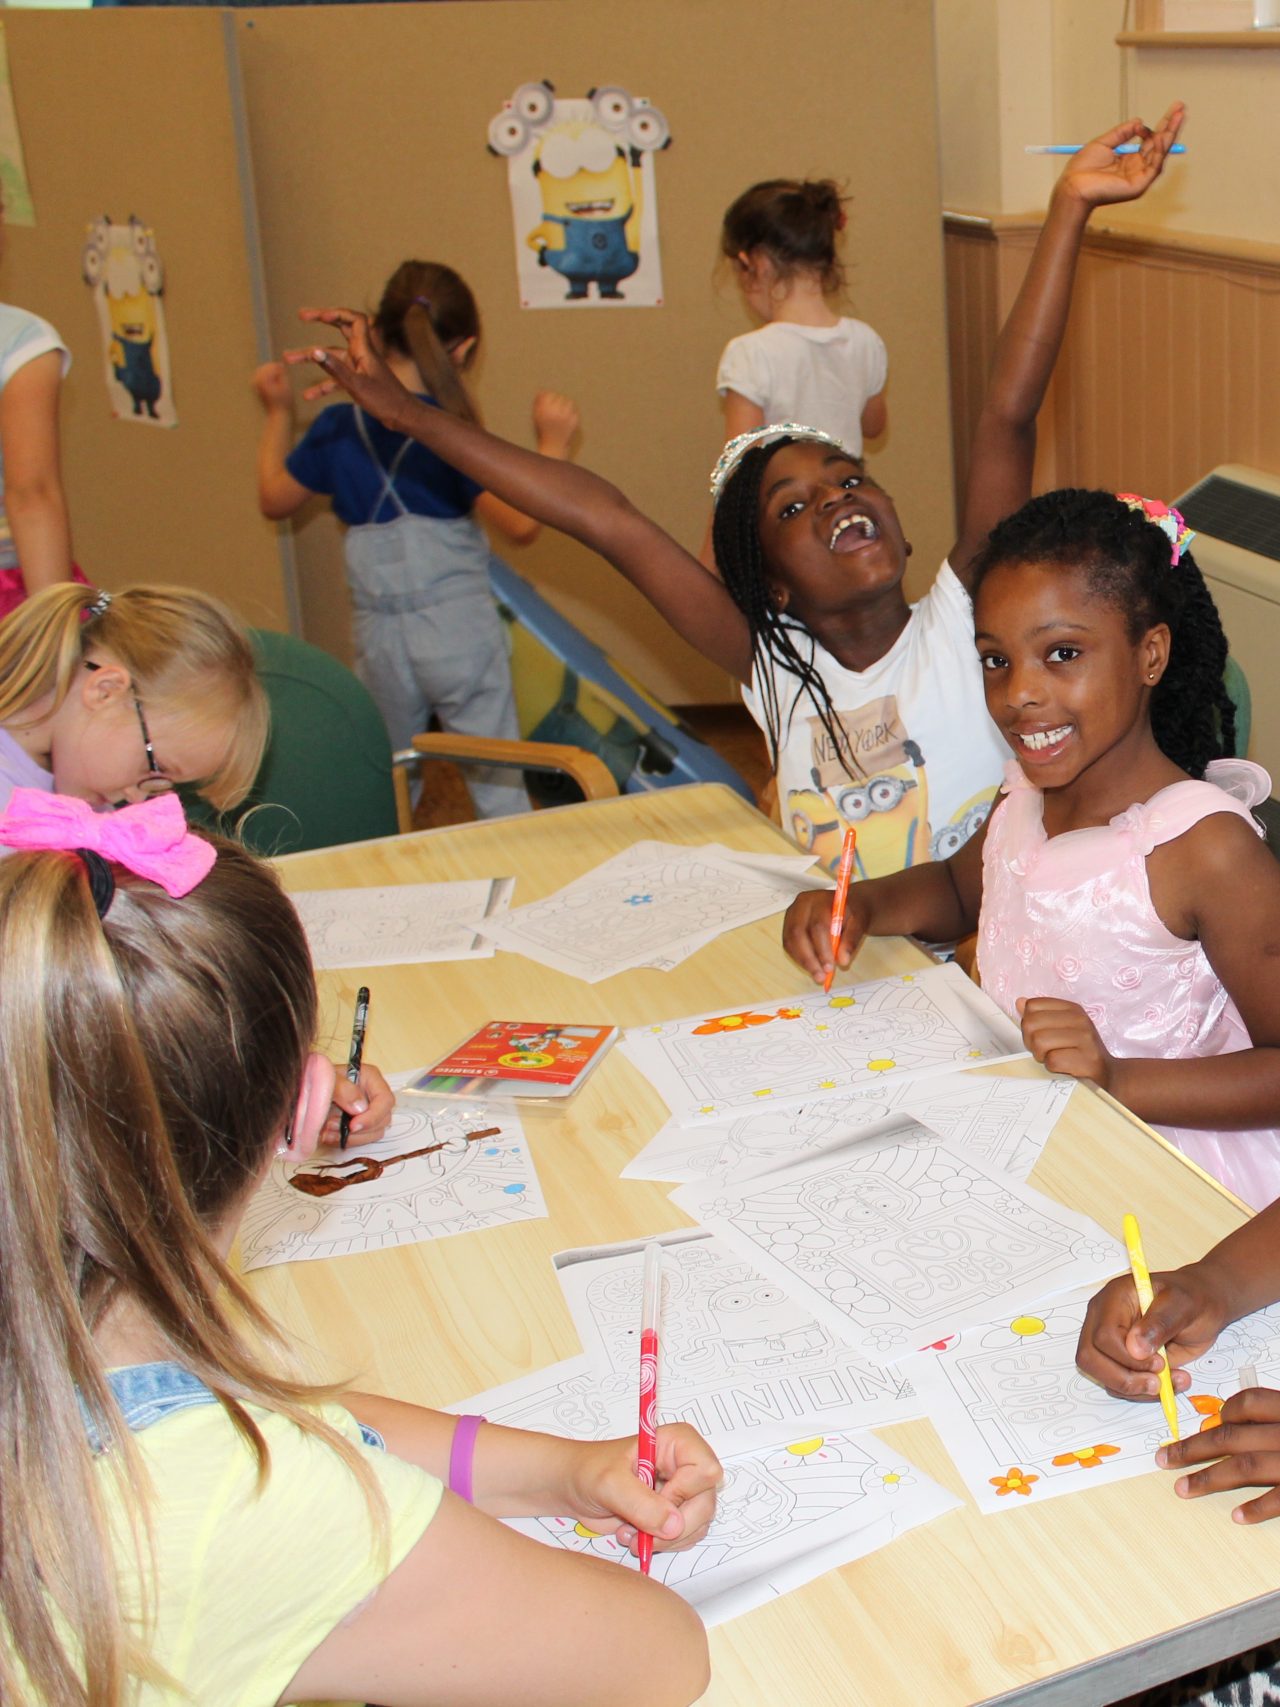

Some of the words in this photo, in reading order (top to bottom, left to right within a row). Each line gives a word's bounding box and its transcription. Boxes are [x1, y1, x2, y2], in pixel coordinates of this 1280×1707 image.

[813, 733, 850, 765] NEW
[854, 719, 898, 753] YORK
[253, 1173, 525, 1250] PEACE
